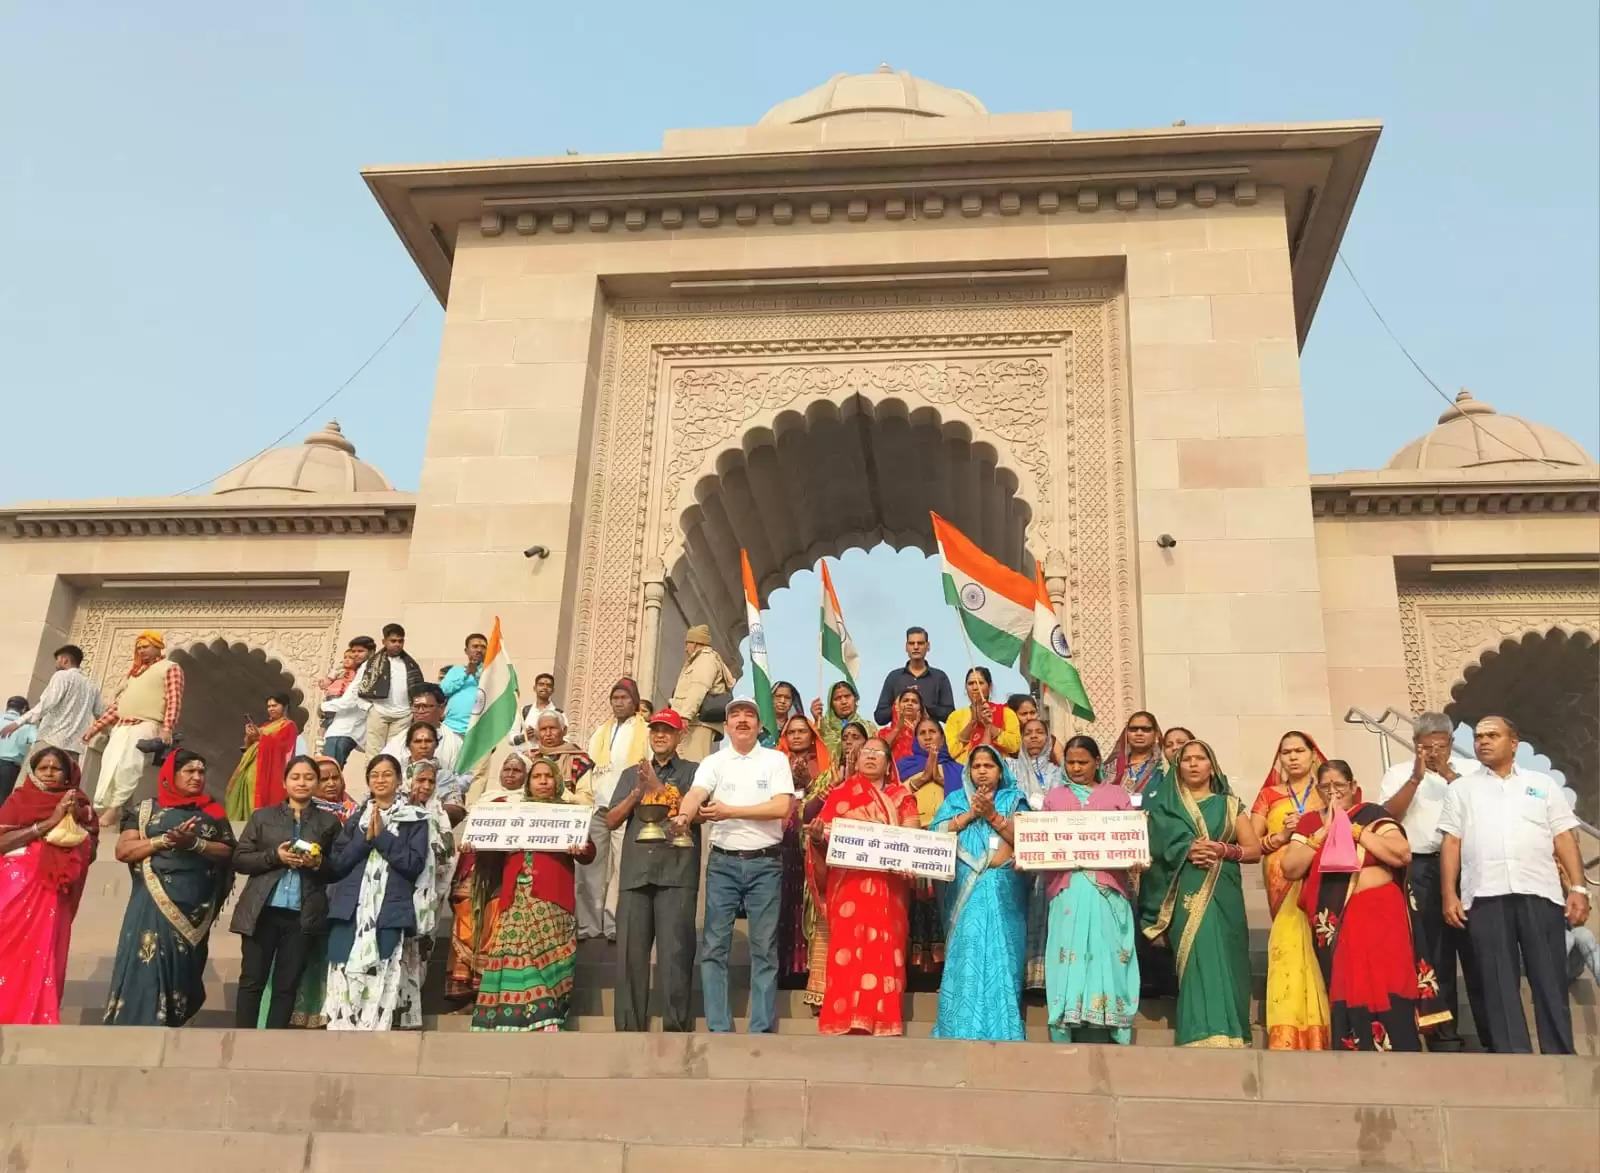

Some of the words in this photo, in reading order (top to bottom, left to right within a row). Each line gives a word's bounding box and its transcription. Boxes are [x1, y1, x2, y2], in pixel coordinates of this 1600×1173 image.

[471, 818, 506, 828] स्वच्छता
[510, 816, 525, 828] को
[528, 818, 571, 829] अपनाना
[467, 832, 499, 842] गन्दगी
[1019, 830, 1048, 842] आओ
[1053, 832, 1074, 841] एक
[1077, 831, 1105, 841] कदम
[833, 834, 864, 847] स्वच्छता
[868, 838, 881, 849] की
[884, 840, 911, 853] ज्योति
[831, 847, 847, 860] देश
[855, 851, 869, 863] को
[879, 855, 902, 867] सुन्दर
[1019, 850, 1045, 862] भारत
[1050, 848, 1067, 861] को
[1072, 849, 1100, 861] स्वच्छ
